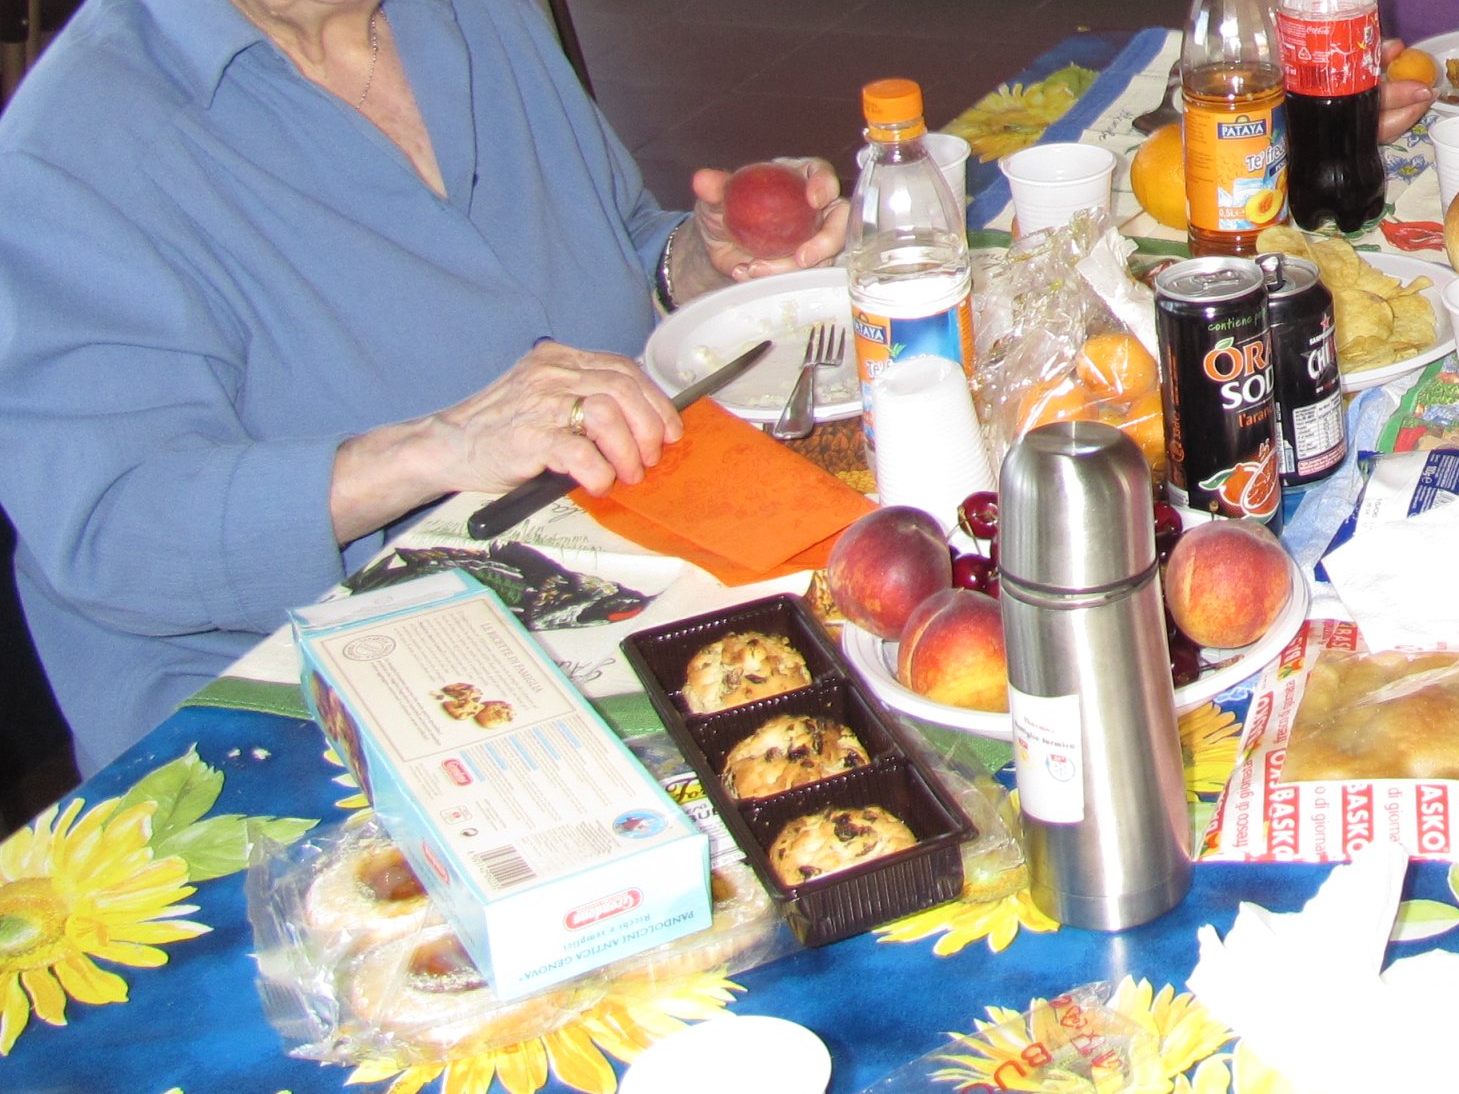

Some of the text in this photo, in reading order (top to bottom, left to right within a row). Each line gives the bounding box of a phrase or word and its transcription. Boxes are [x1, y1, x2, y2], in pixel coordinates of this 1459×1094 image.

[1221, 123, 1264, 137] PATAYA
[1420, 785, 1446, 851] ASKO
[623, 910, 695, 945] PANDOLCINI
[575, 940, 619, 960] ANTICA
